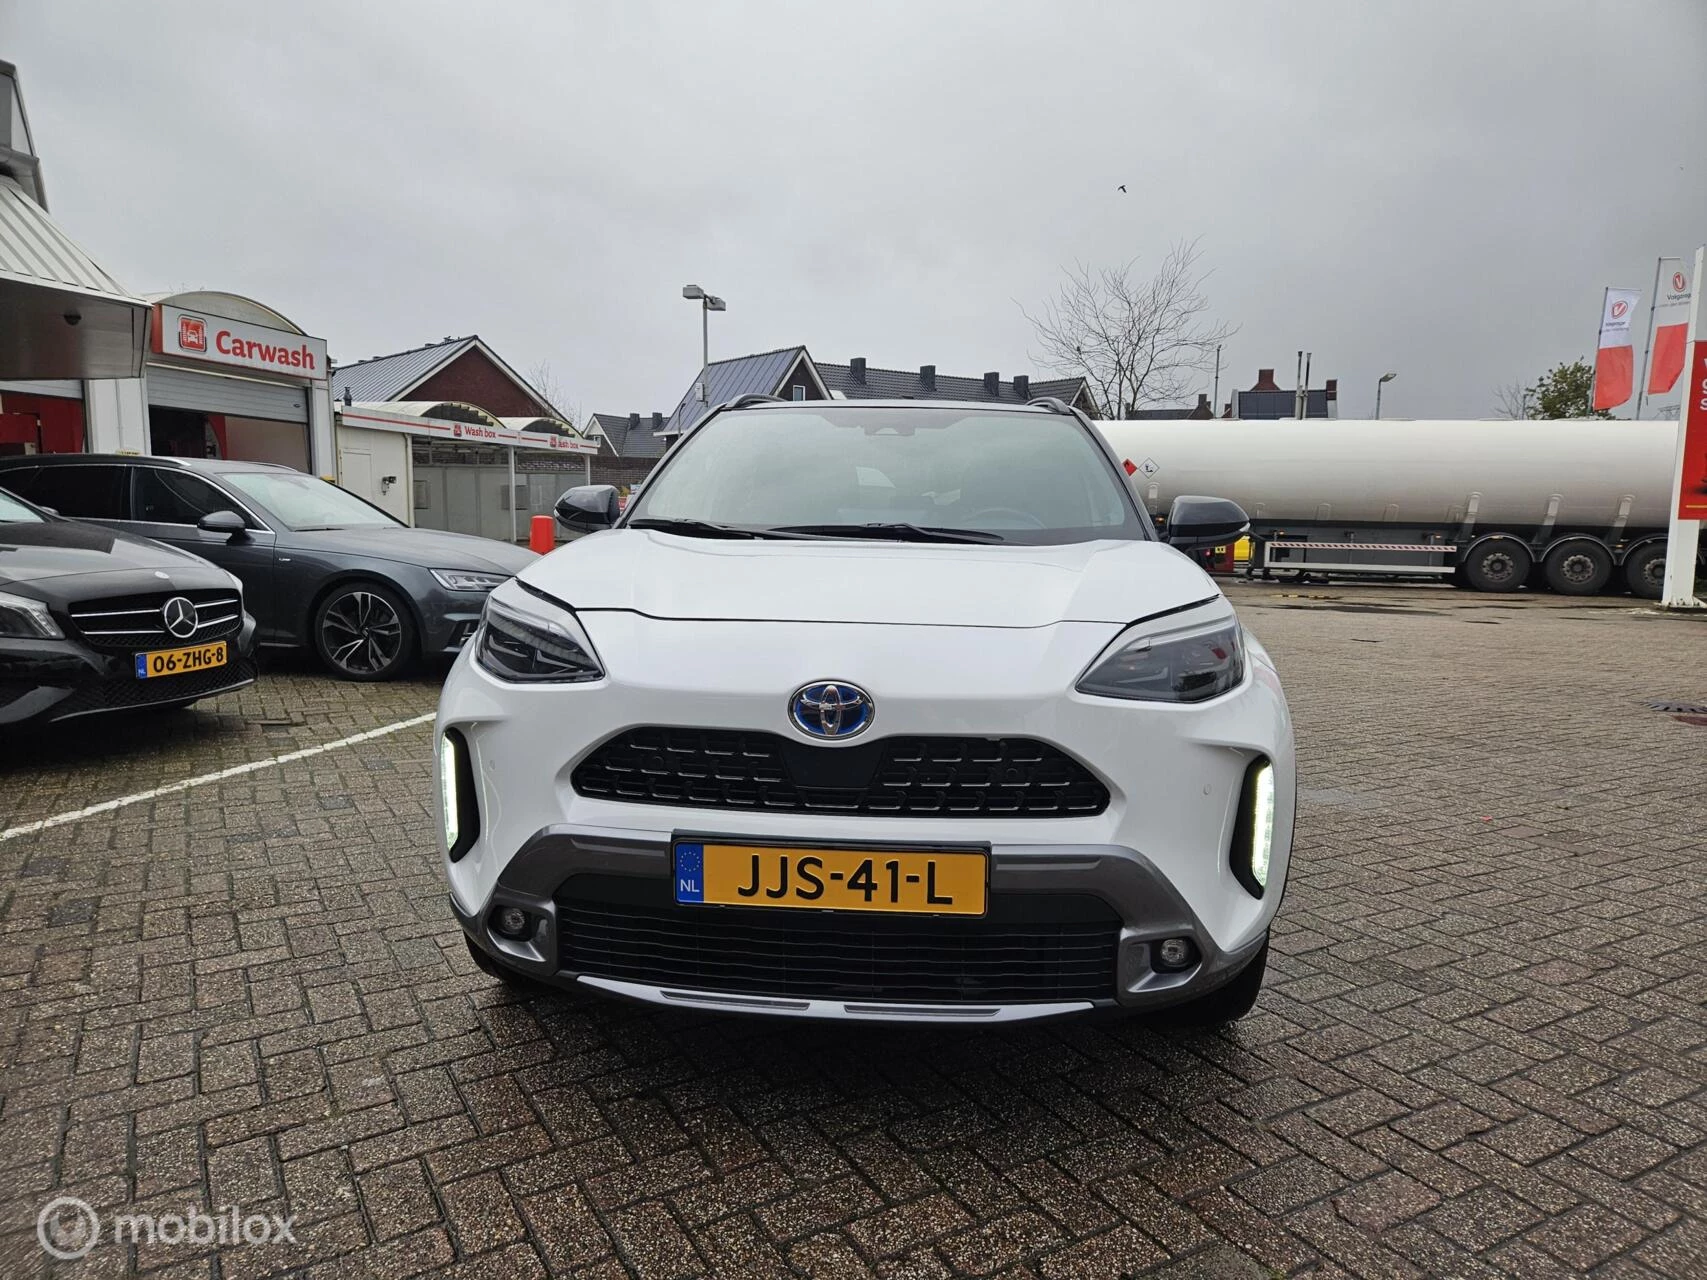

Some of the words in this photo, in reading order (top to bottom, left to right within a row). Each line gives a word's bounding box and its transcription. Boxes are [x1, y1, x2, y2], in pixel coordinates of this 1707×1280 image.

[215, 330, 315, 370] Carwash
[464, 425, 483, 437] Wash
[484, 427, 496, 438] box
[558, 440, 569, 448] ash
[153, 647, 223, 673] 06-ZHG-8
[680, 879, 700, 893] NL
[737, 853, 953, 905] JJS-41-L
